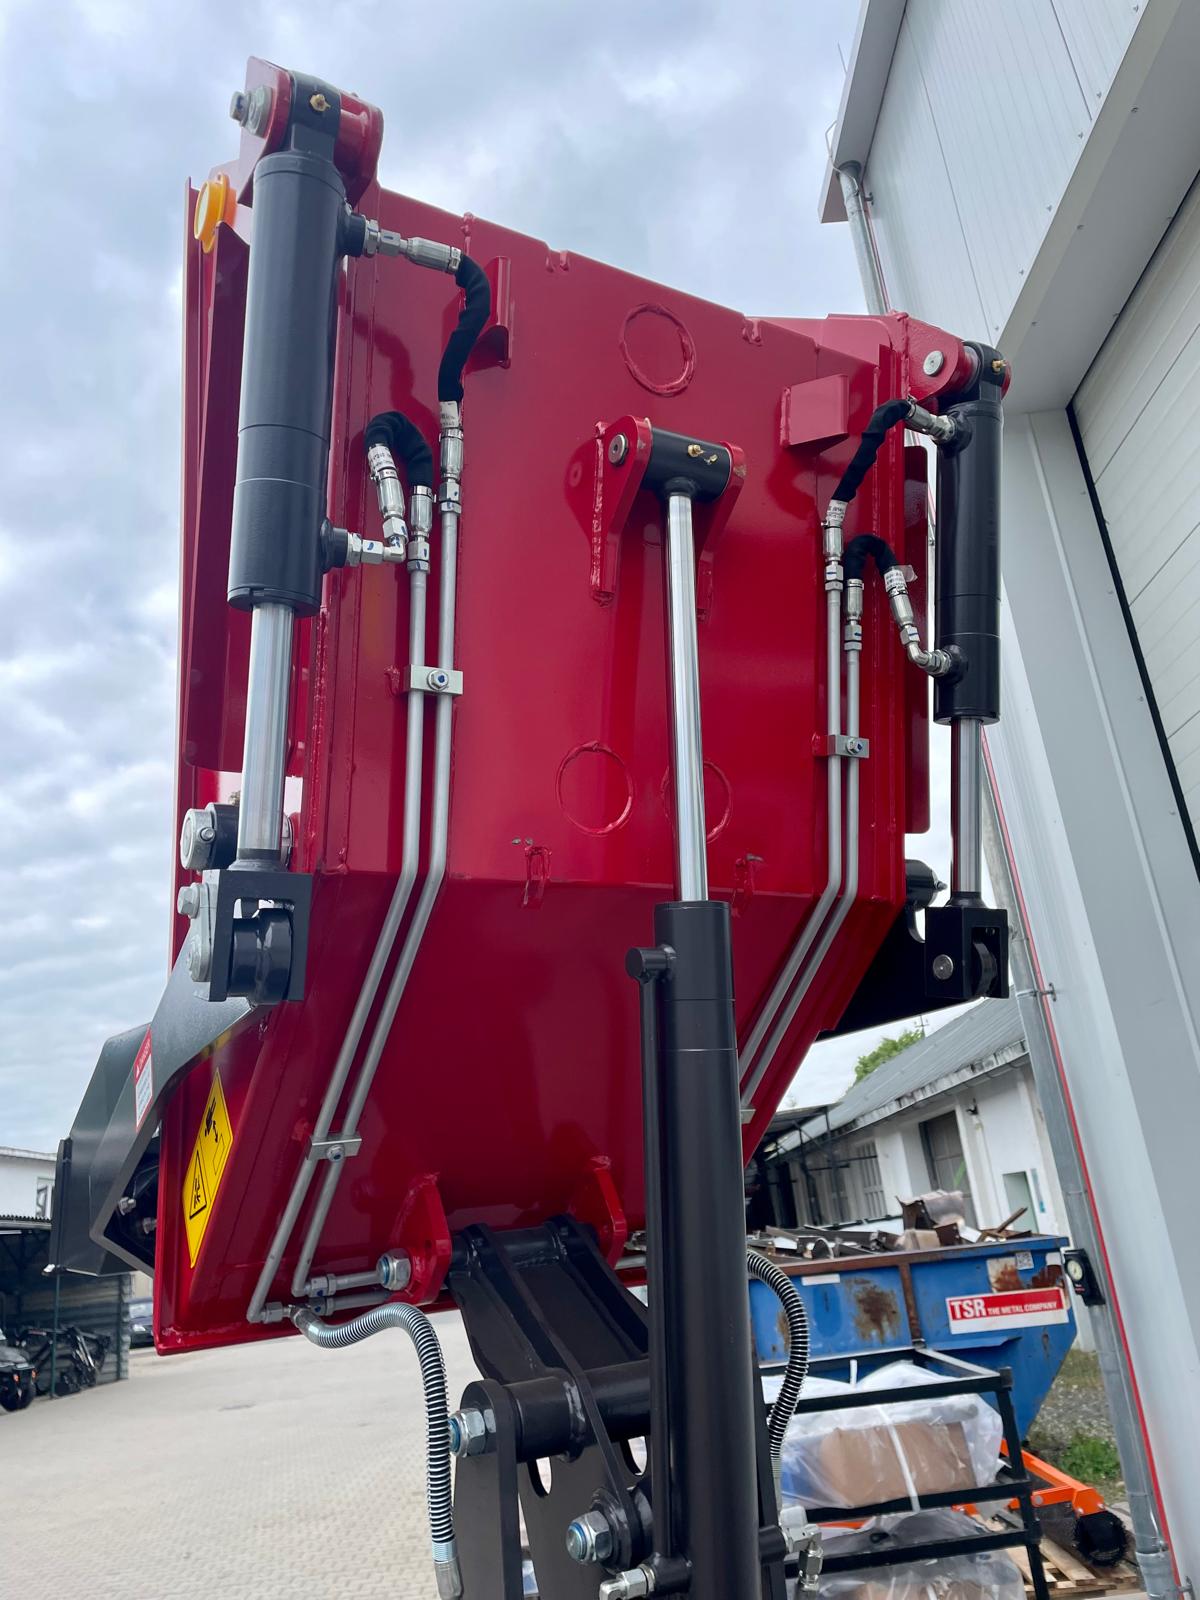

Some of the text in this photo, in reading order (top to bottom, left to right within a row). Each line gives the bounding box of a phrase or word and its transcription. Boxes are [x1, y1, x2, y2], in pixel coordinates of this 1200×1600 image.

[951, 1299, 1057, 1318] TSR THE METAL COMPANY
